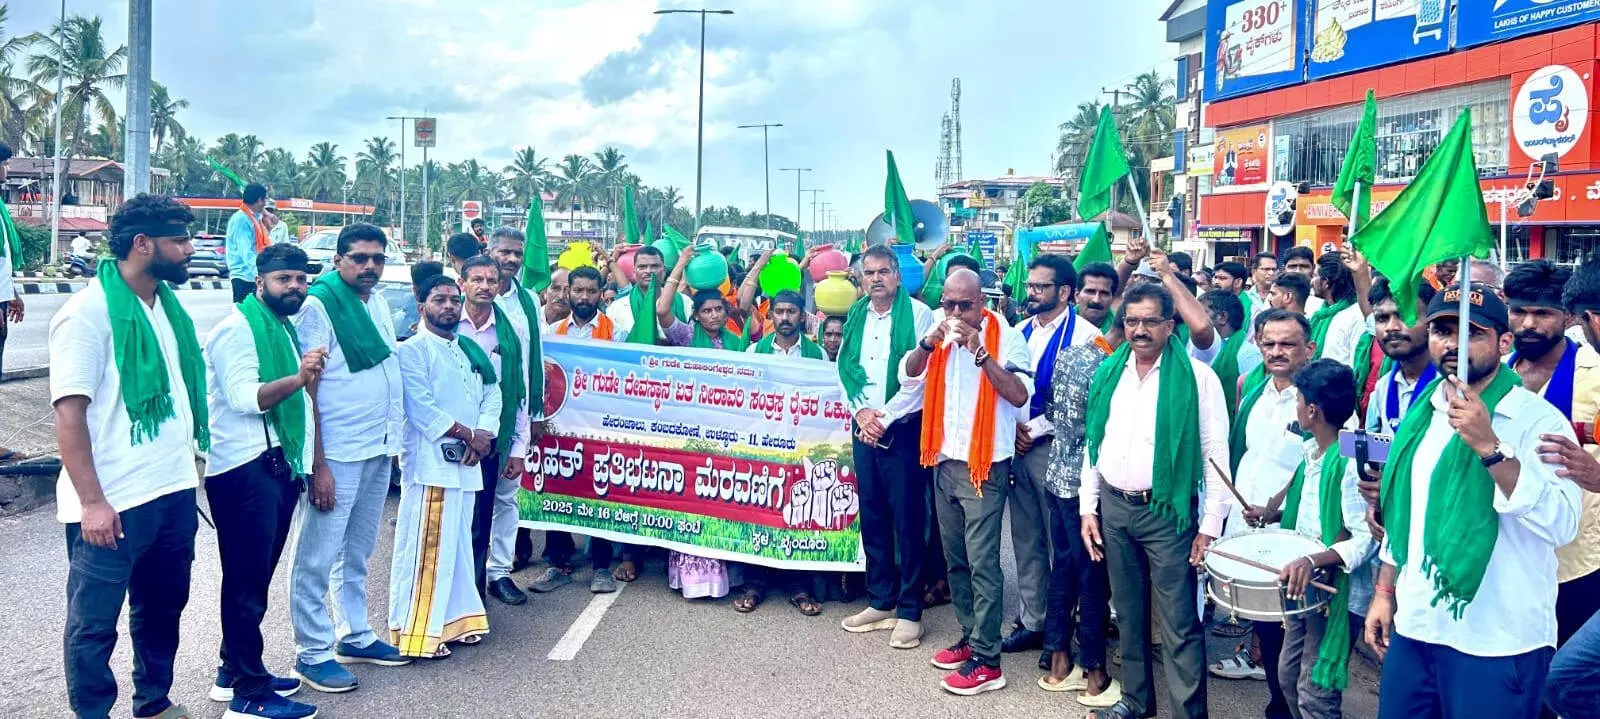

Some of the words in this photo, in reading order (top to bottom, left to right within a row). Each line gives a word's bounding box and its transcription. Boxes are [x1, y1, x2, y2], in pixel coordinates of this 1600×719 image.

[1519, 14, 1530, 23] OF
[1530, 9, 1555, 21] HAPPY
[573, 368, 588, 397] ಶ್ರೀ
[593, 370, 620, 394] ಗುಡೇ
[624, 373, 672, 411] ದೇವಸ್ಥಾನ
[675, 380, 695, 402] ಏತ
[699, 384, 745, 408] ನೀರಾವರಿ
[749, 389, 785, 421] ಸಂತ್ರಸ್ತ
[789, 391, 819, 426] ರೈತರ
[524, 439, 584, 492] ಬೃಹತ್
[593, 445, 685, 496] ಪ್ರತಿಭಟನಾ
[695, 457, 785, 509] ಮೆರವಣಿಗೆ
[543, 500, 573, 514] 2025
[577, 503, 594, 517] ಮೇ
[597, 507, 610, 519] 16
[642, 514, 673, 529] 10:00
[752, 531, 769, 552] ಸ್ಥಳ
[781, 535, 827, 556] ಬೈಂದೂರು
